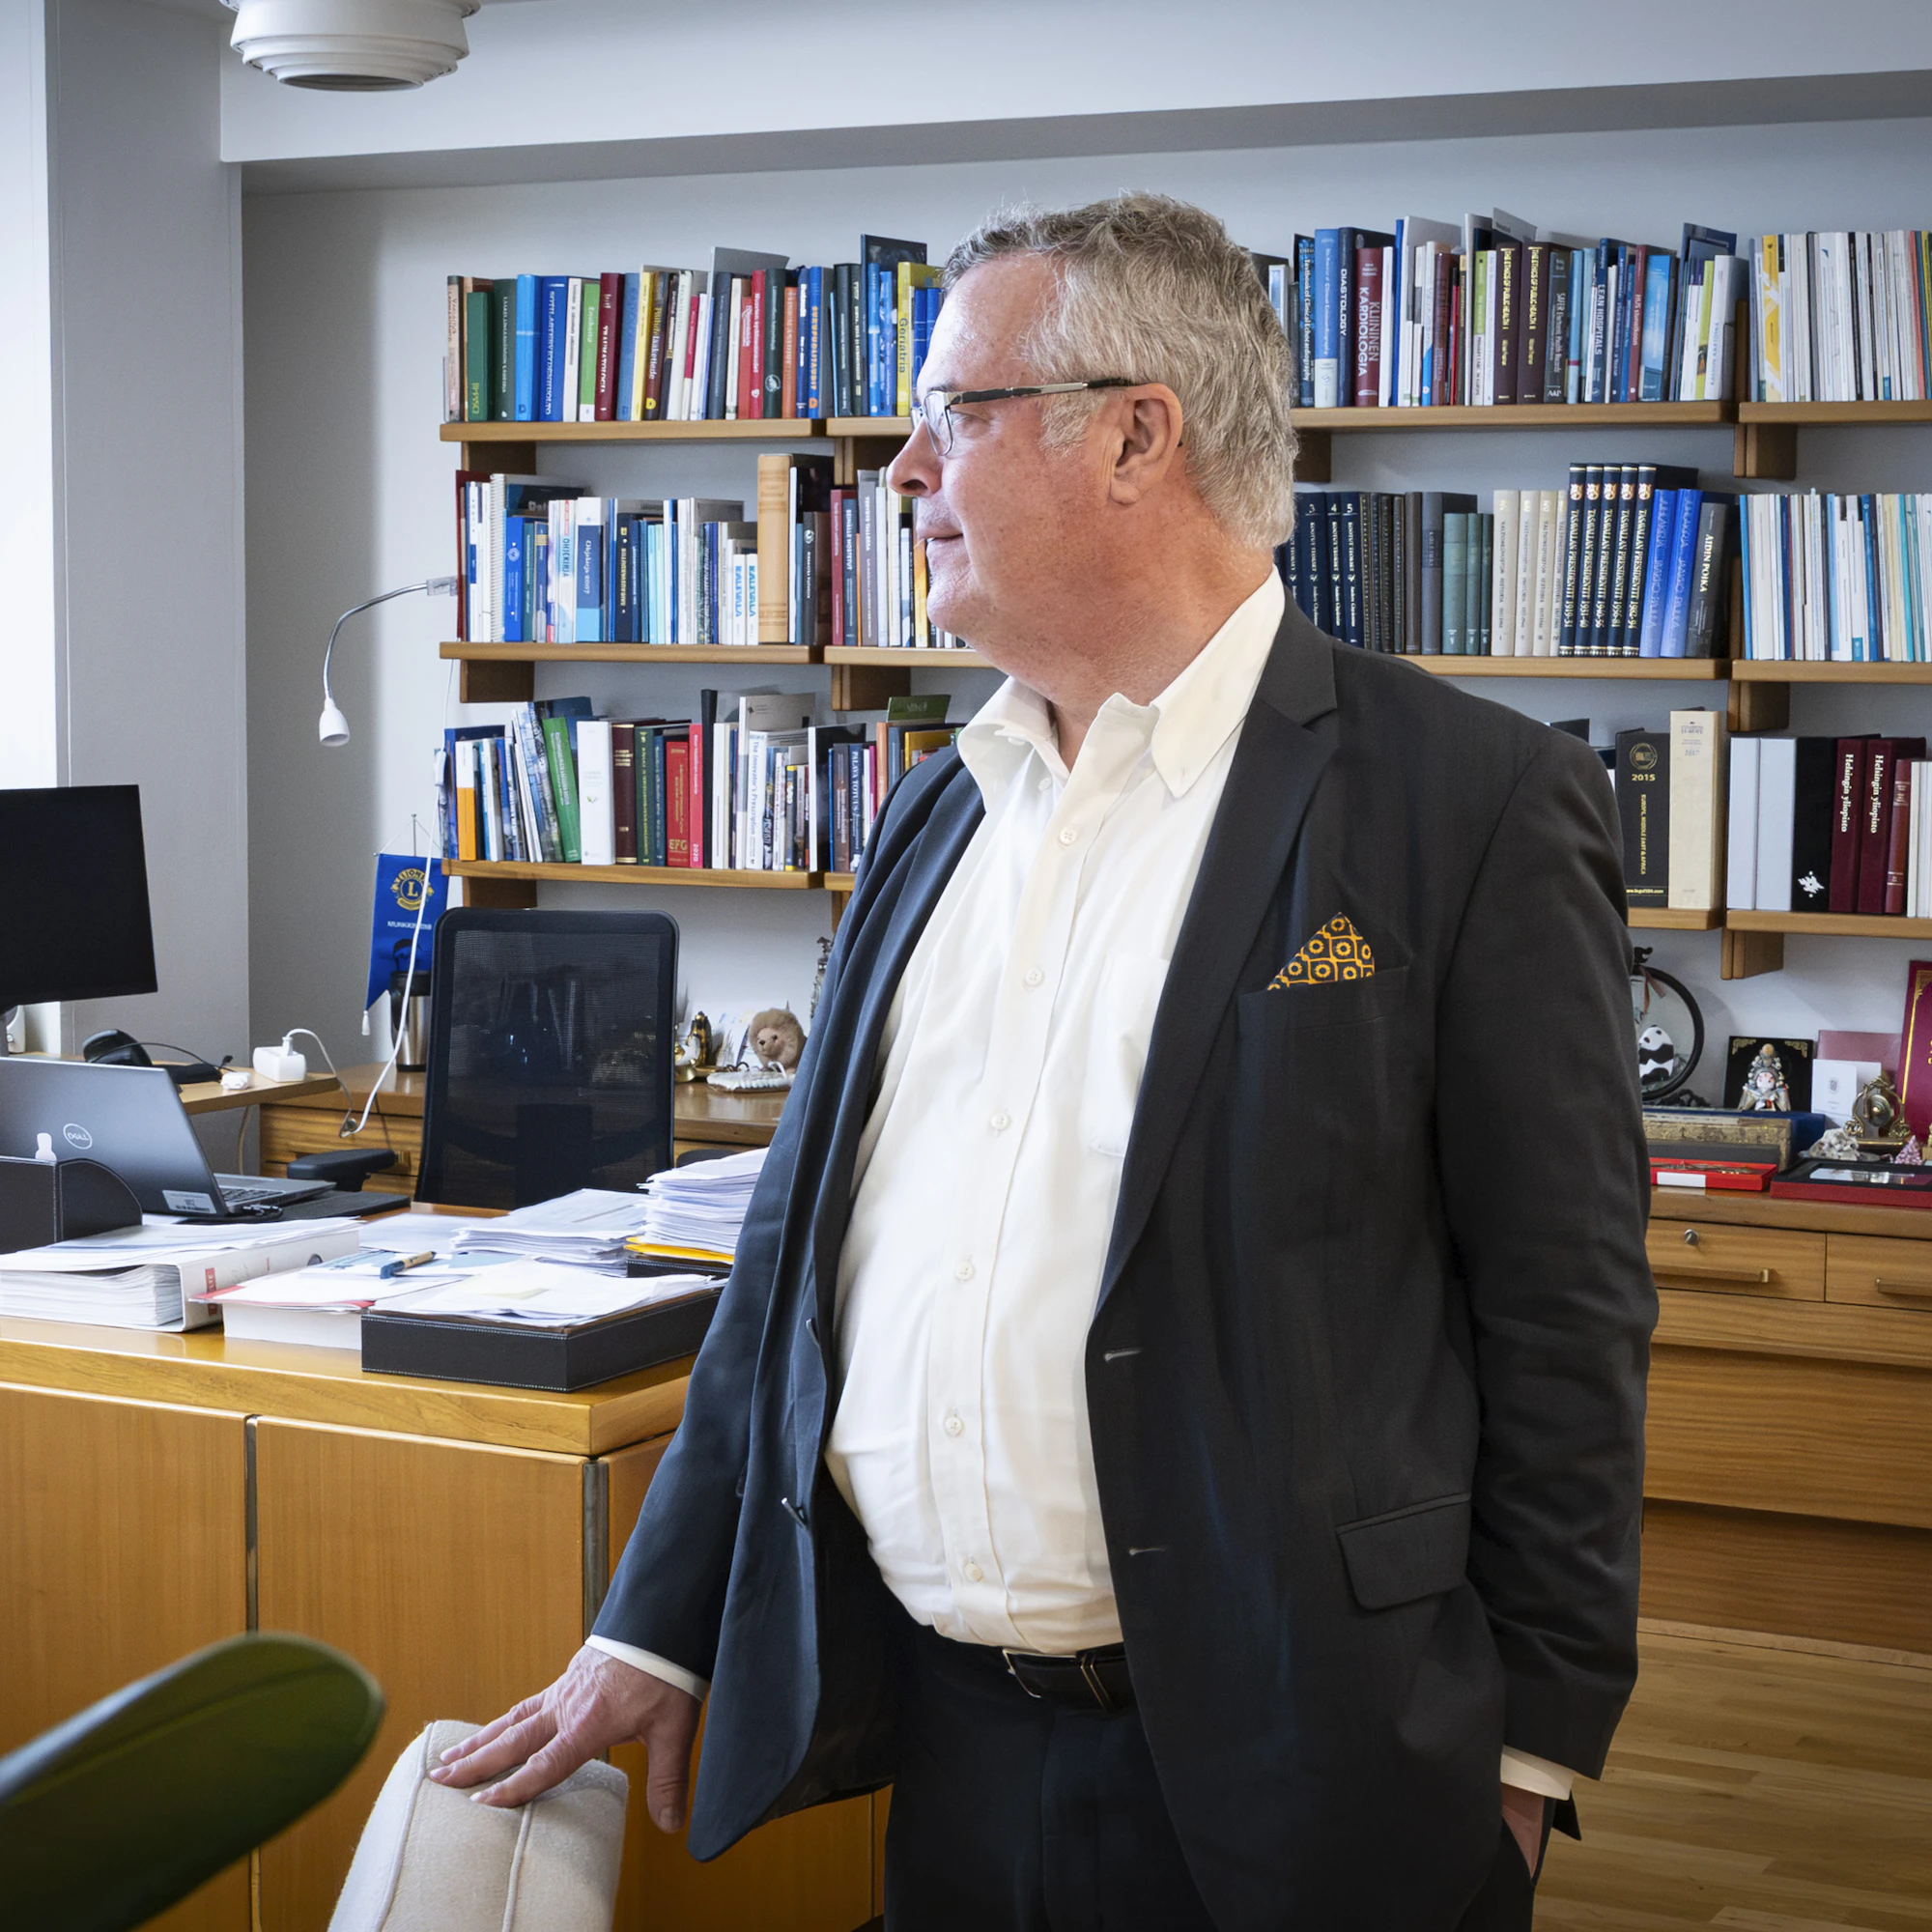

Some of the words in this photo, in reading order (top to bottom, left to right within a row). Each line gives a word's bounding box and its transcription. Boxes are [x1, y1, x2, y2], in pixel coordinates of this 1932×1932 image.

[1503, 251, 1512, 261] THE
[1503, 261, 1512, 279] ETHICS
[1531, 249, 1540, 259] THE
[1531, 259, 1540, 278] ETHICS
[1303, 258, 1312, 289] Textbook
[1339, 269, 1348, 336] DIASTOLOGY
[1502, 287, 1511, 305] PUBLIC
[1530, 285, 1539, 304] PUBLIC
[1556, 293, 1566, 310] SAFER
[1597, 284, 1605, 306] LEAN
[1357, 286, 1369, 377] KARDIOLOGIA
[1369, 301, 1380, 361] KLIININEN
[1502, 305, 1511, 326] HEALTH
[1529, 304, 1538, 325] HEALTH
[1594, 308, 1605, 355] HOSPITALS
[600, 325, 609, 393] TRAUMATOLOGIA
[898, 318, 909, 374] Geriatria
[1302, 323, 1311, 381] Echocardiography
[1308, 503, 1315, 513] 3
[1330, 503, 1338, 512] 4
[1346, 503, 1353, 513] 5
[1569, 509, 1579, 550] TASAVALLAN
[1585, 509, 1597, 550] TASAVALLAN
[1602, 509, 1613, 550] TASAVALLAN
[1619, 509, 1631, 550] TASAVALLAN
[1635, 509, 1647, 550] TASAVALLAN
[561, 538, 571, 578] OHJEKIRJA
[582, 539, 592, 574] Ohjekirja
[1565, 551, 1577, 599] PRESIDENTIT
[1581, 551, 1594, 599] PRESIDENTIT
[1597, 551, 1609, 599] PRESIDENTIT
[1614, 551, 1628, 599] PRESIDENTIT
[1631, 551, 1643, 599] PRESIDENTIT
[582, 575, 591, 594] 2007
[1700, 563, 1710, 592] POIKA
[1595, 600, 1605, 628] 1940-56
[1628, 600, 1639, 629] 1982-94
[1841, 753, 1854, 794] Helsingin
[1871, 754, 1884, 795] Helsingin
[1839, 795, 1852, 833] yliopisto
[1868, 797, 1881, 834] yliopisto
[407, 881, 418, 897] L
[68, 1132, 90, 1141] DELL
